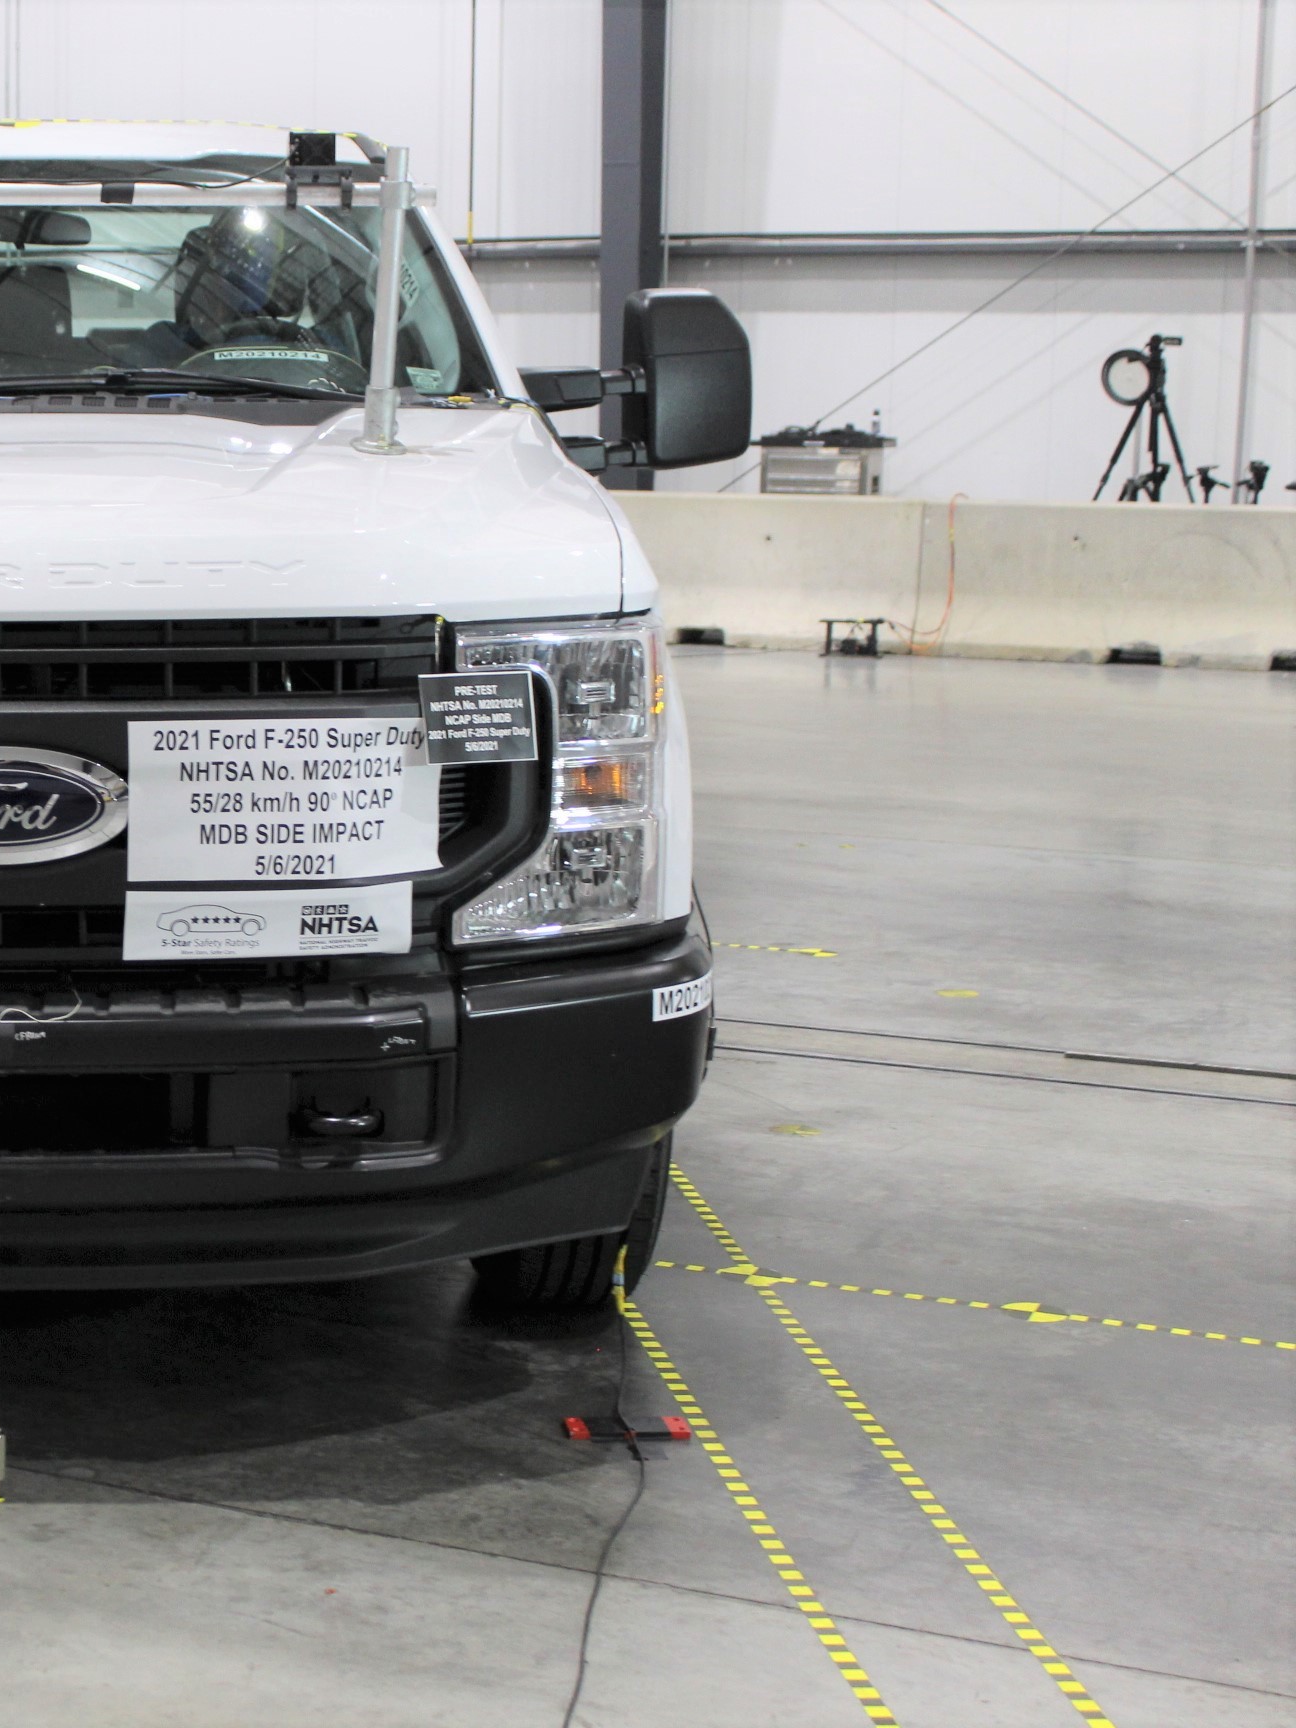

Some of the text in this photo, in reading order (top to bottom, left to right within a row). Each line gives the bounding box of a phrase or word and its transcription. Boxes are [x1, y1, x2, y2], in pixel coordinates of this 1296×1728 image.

[219, 351, 321, 360] M20210214
[49, 560, 304, 589] DUTY
[454, 685, 498, 696] PRE-TEST
[430, 700, 462, 712] NHTSA
[444, 713, 512, 725] NCAP Side MDB
[153, 726, 426, 753] 2021 Ford F-250 Super Duty
[428, 726, 531, 740] 2021 Ford F-250 Super Duty
[180, 756, 403, 782] NHTSA No. M20210214
[190, 792, 243, 814] 55/28
[251, 791, 300, 813] km/h
[342, 788, 394, 811] NCAP
[199, 820, 384, 845] MDB SIDE IMPACT
[255, 854, 336, 876] 5/6/2021
[300, 915, 379, 935] NHTSA
[161, 939, 192, 948] 5-Star
[194, 938, 222, 949] Safety
